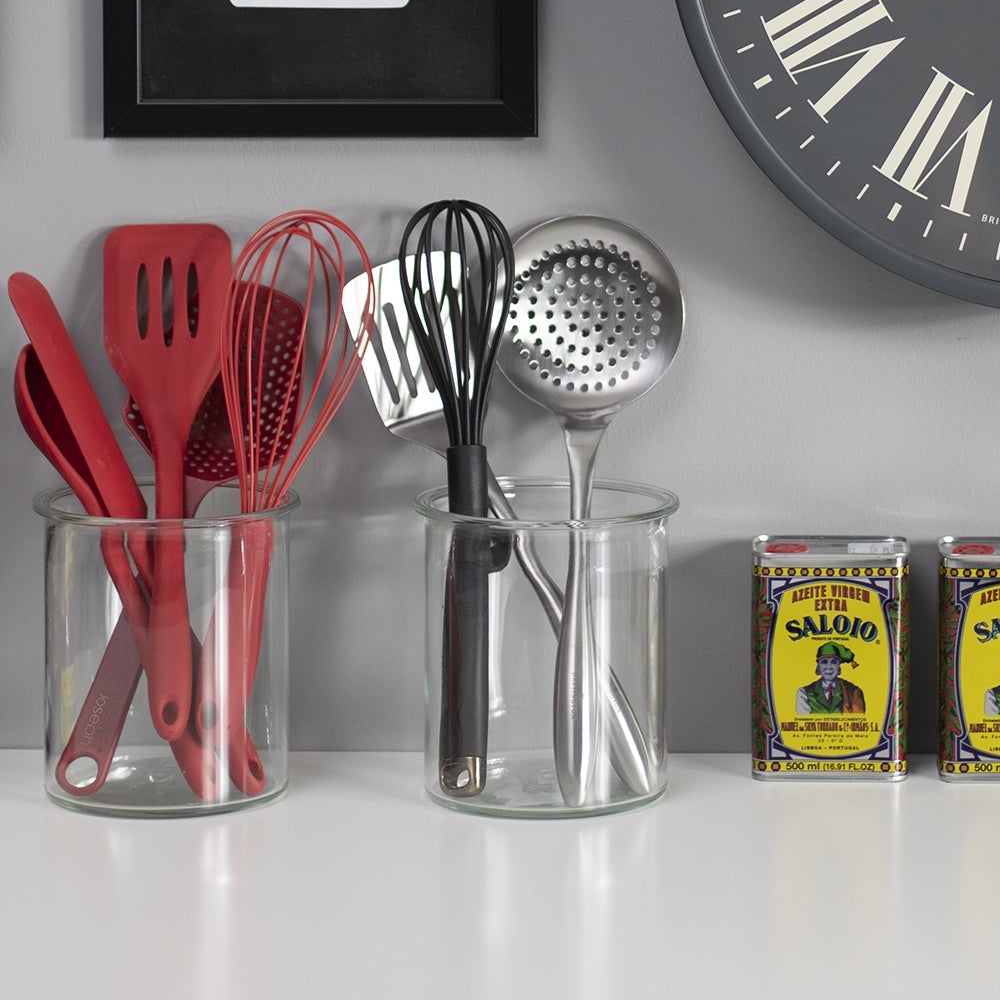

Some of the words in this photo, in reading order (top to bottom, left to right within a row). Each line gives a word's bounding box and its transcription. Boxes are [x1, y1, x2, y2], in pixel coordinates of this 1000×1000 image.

[792, 585, 827, 603] AZEITE
[831, 585, 870, 603] VIRGEM
[814, 598, 848, 612] EXTRA
[785, 614, 878, 642] SALOIO
[786, 762, 804, 770] 500
[808, 762, 820, 770] ml
[823, 763, 846, 771] (16.91
[974, 763, 993, 772] 500
